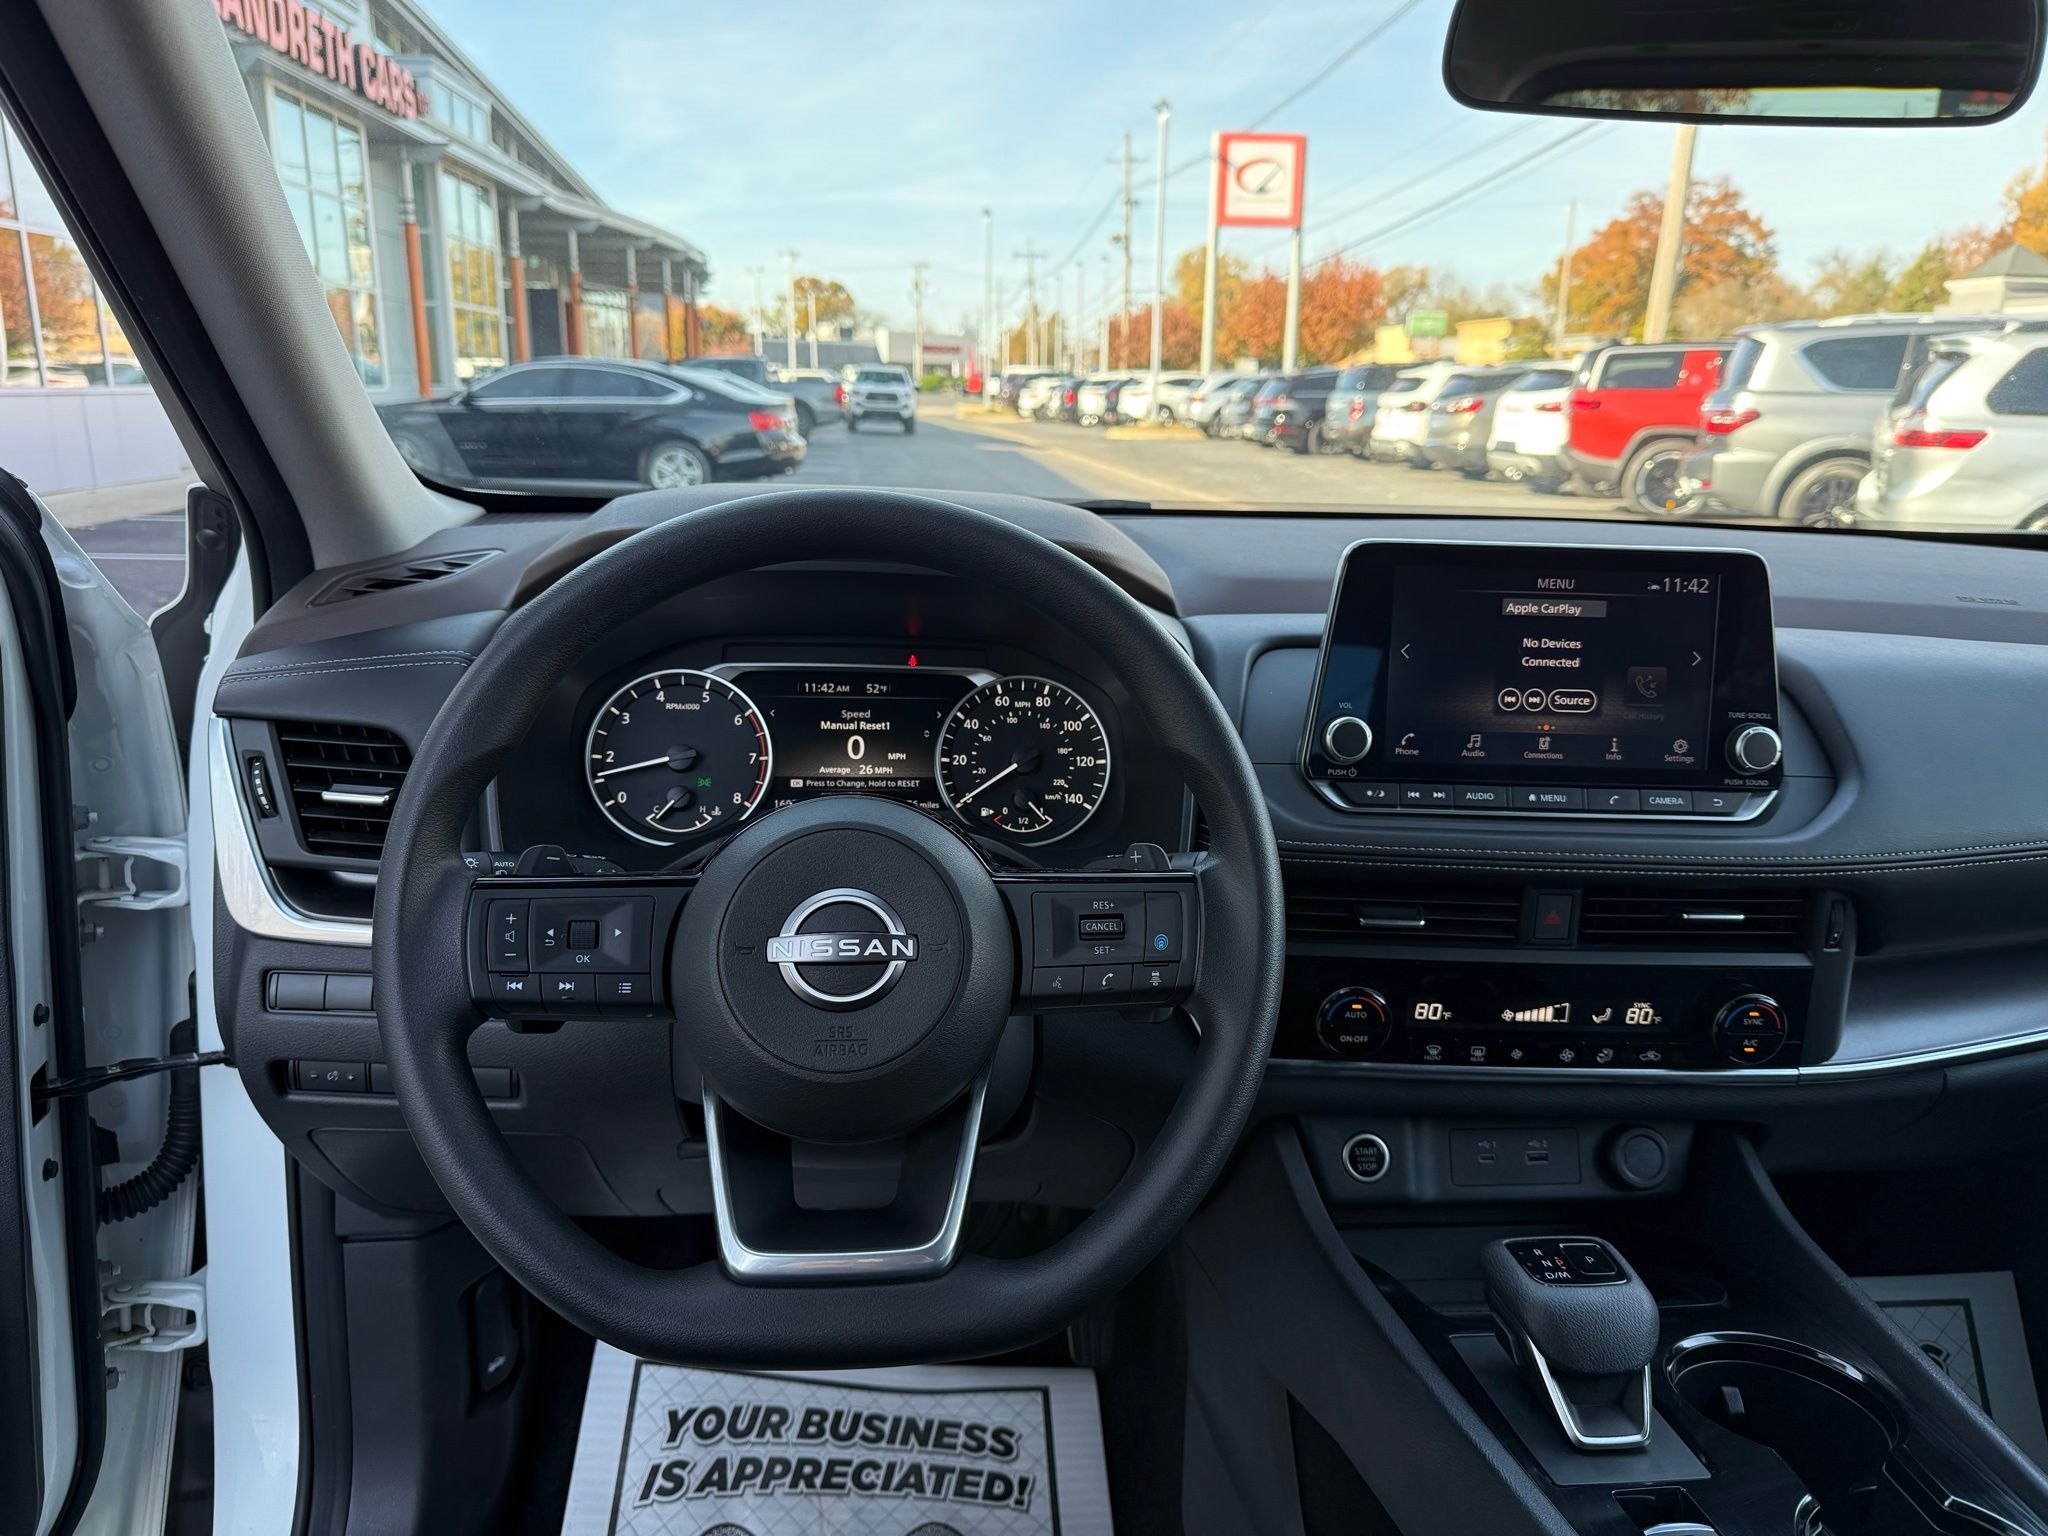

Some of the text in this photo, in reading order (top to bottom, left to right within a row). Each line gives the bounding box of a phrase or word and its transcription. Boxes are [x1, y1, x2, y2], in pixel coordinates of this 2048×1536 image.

[215, 0, 417, 120] ANDRETH CARS
[1537, 579, 1575, 589] MENU
[1663, 578, 1709, 594] 11:42
[1506, 603, 1581, 617] Apple CarPlay
[1523, 638, 1581, 649] No Devices
[1521, 656, 1580, 668] Connected
[804, 682, 835, 693] 11:42
[656, 691, 665, 701] 4
[702, 692, 710, 702] 5
[995, 696, 1010, 706] 60
[1554, 696, 1591, 705] Source
[1035, 697, 1051, 707] 80
[622, 713, 630, 723] 3
[734, 714, 742, 724] 6
[841, 710, 871, 720] Speed
[820, 721, 890, 730] Manual Reset1
[963, 718, 979, 729] 40
[1063, 720, 1082, 731] 100
[847, 735, 865, 759] 0
[1395, 748, 1419, 756] Phone
[605, 751, 614, 762] 2
[749, 753, 757, 764] 7
[952, 754, 967, 765] 20
[1524, 751, 1563, 760] Connections
[1664, 754, 1695, 763] Settings
[1076, 756, 1095, 767] 120
[819, 766, 851, 775] Average
[859, 765, 874, 774] 26
[836, 780, 867, 789] Change,
[617, 791, 627, 802] 0
[733, 792, 742, 803] 8
[1045, 793, 1061, 801] km/h
[1064, 793, 1083, 804] 140
[1465, 792, 1494, 800] AUDIO
[1540, 794, 1566, 802] MENU
[1649, 797, 1684, 805] CAMERA
[653, 805, 660, 813] C
[700, 805, 706, 813] H
[1093, 901, 1115, 909] RES+
[1085, 922, 1118, 931] CANCEL
[772, 939, 914, 958] NISSAN
[575, 955, 590, 963] OK
[1345, 1011, 1367, 1019] AUTO
[829, 1026, 853, 1038] SRS
[813, 1043, 868, 1057] AIRBAG
[1354, 1147, 1377, 1155] START
[1357, 1162, 1377, 1171] STOP
[1533, 1248, 1543, 1256] R
[1541, 1259, 1553, 1267] N
[1585, 1255, 1595, 1264] P
[1545, 1271, 1571, 1279] D/M
[664, 1404, 1018, 1458] YOUR BUSINESS
[638, 1456, 1031, 1506] IS APPRECIATED!
